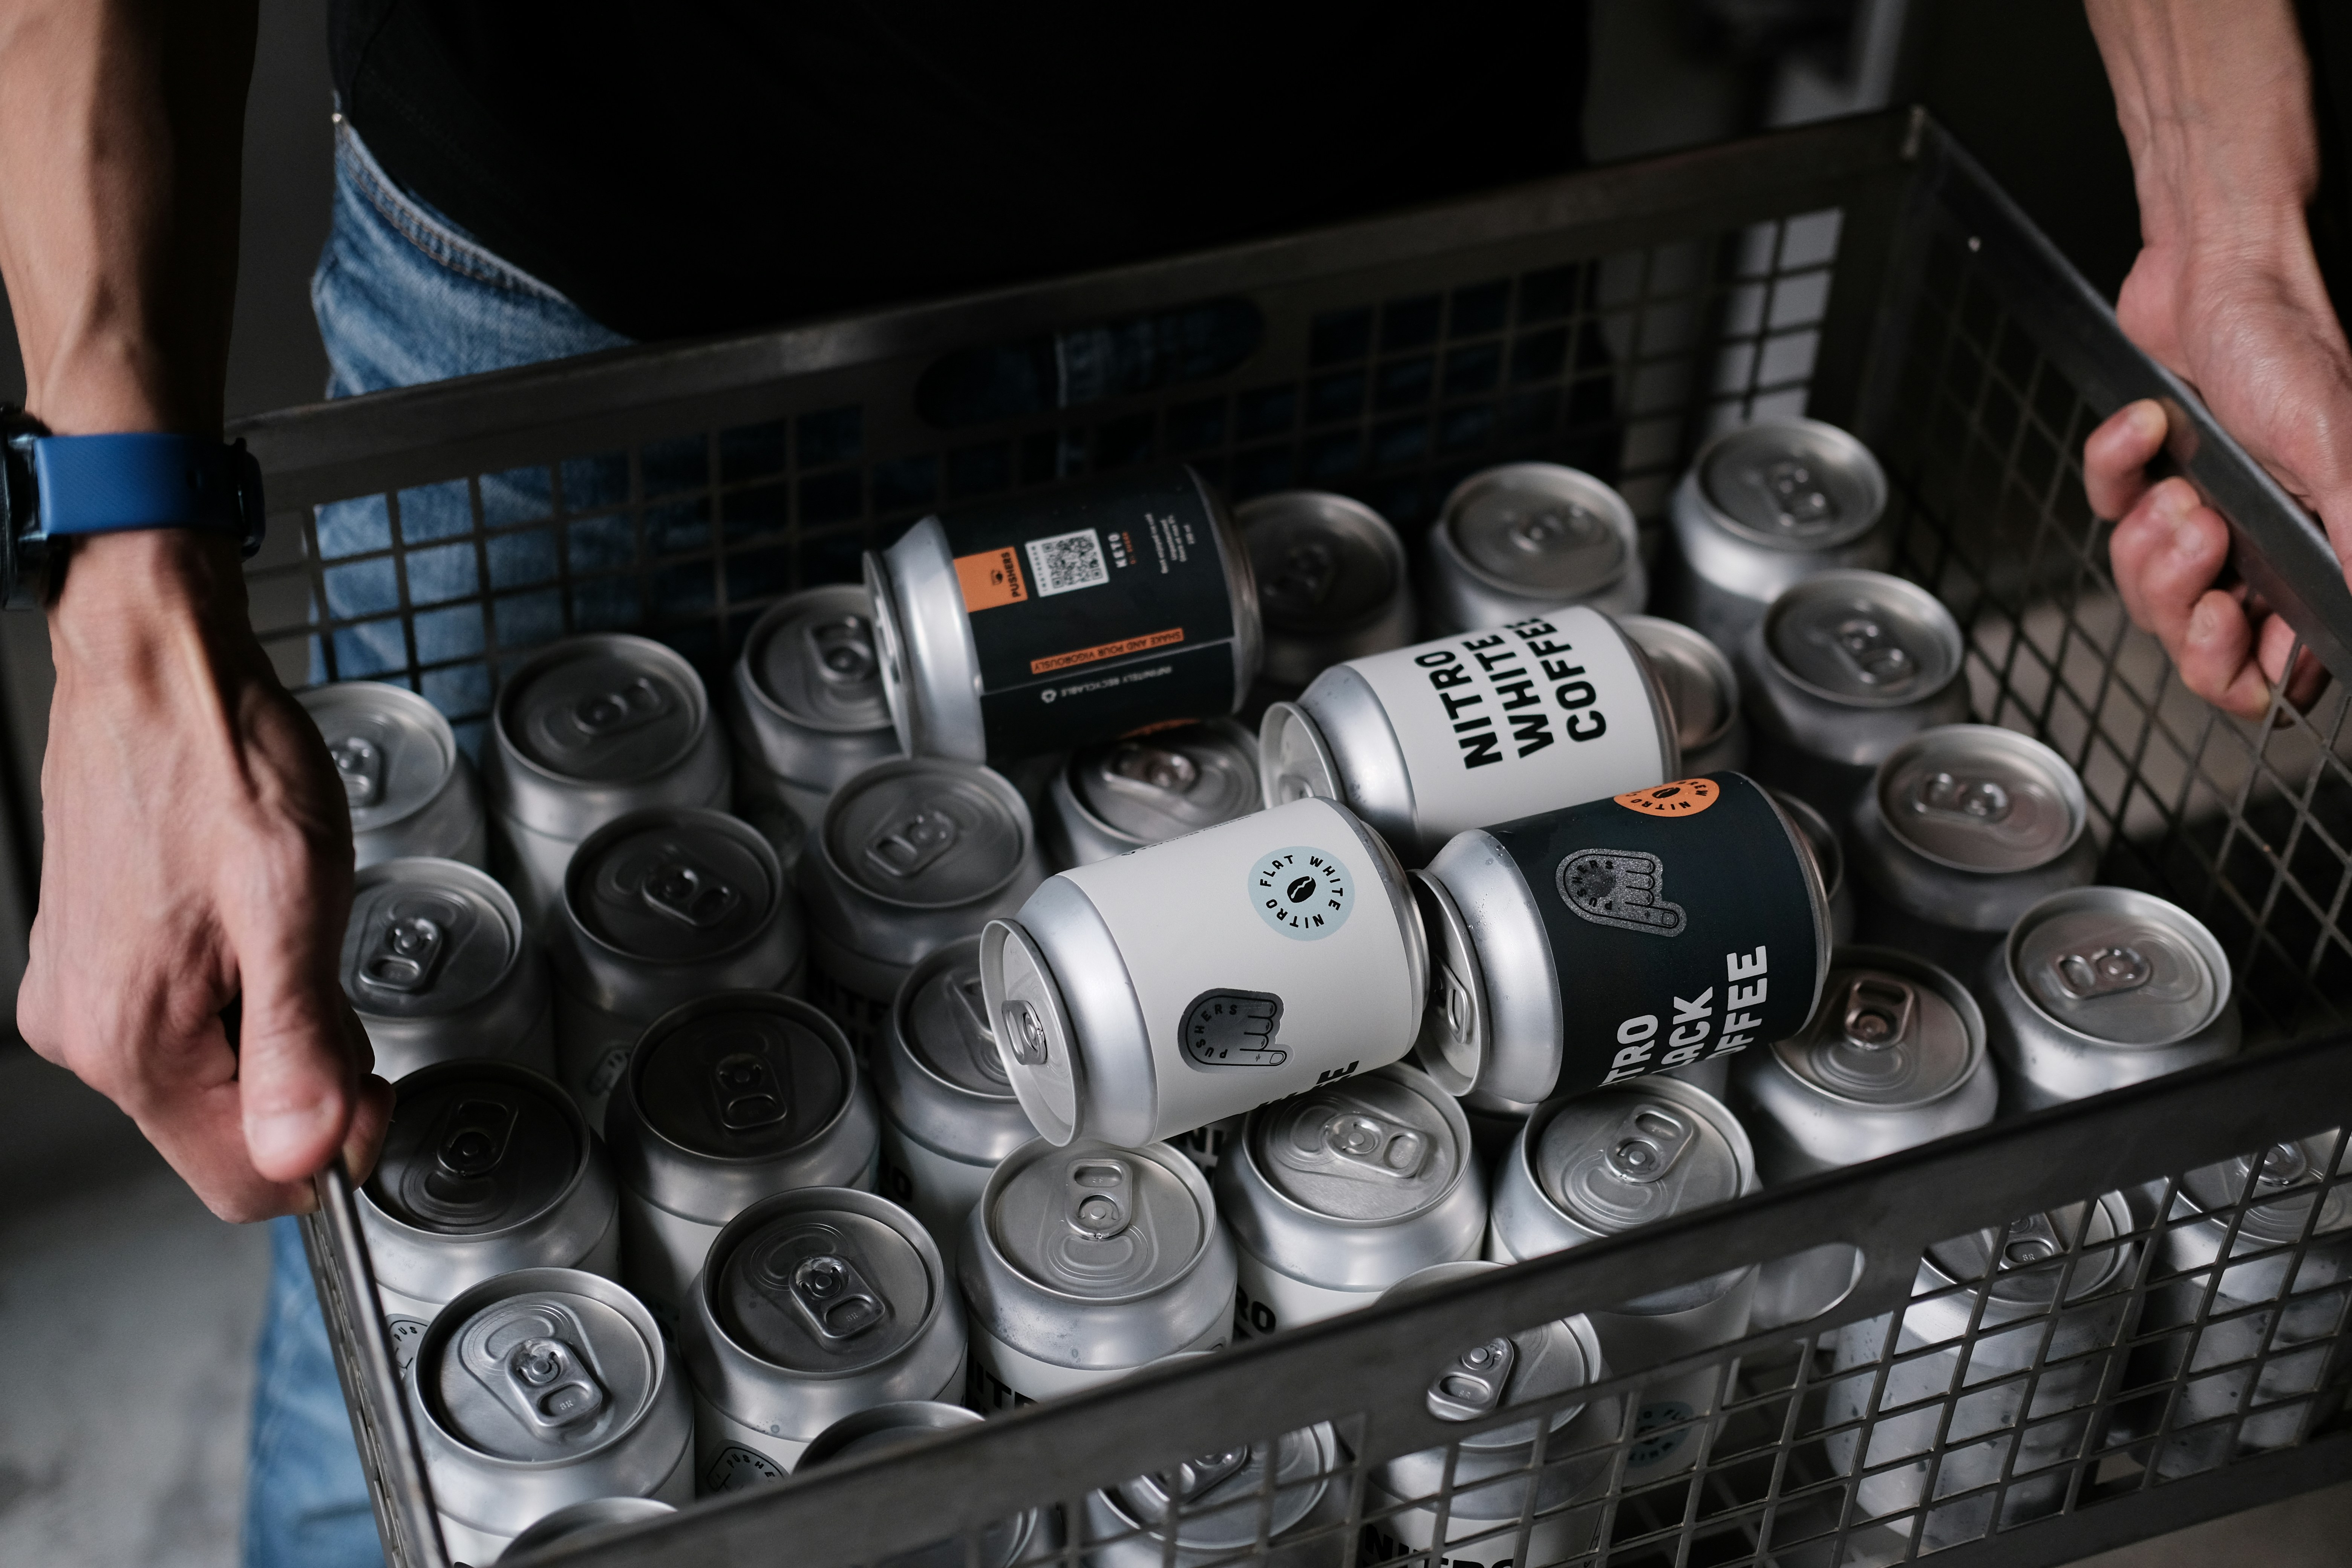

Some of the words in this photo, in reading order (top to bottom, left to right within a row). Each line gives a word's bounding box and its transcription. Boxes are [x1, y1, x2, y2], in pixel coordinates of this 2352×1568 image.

[1002, 552, 1020, 597] PUSHERS
[1098, 645, 1124, 657] POUR
[1126, 639, 1147, 651] AND
[1151, 632, 1182, 647] SHAKE
[1035, 652, 1096, 671] VIGOROUSLY
[1061, 678, 1120, 696] RECYCLABLE
[1462, 634, 1554, 759] WHITE
[1414, 651, 1503, 769] NITRO
[1631, 799, 1691, 810] NITRO
[1260, 854, 1294, 887] FLAT
[1309, 856, 1343, 911] WHITE
[1572, 859, 1614, 910] PUSHERS
[1266, 899, 1325, 929] NITRO
[1194, 1004, 1237, 1059] PUSHERS
[1598, 1014, 1658, 1087] TRO
[2022, 1253, 2035, 1262] 8R
[726, 1453, 775, 1478] PUSHE
